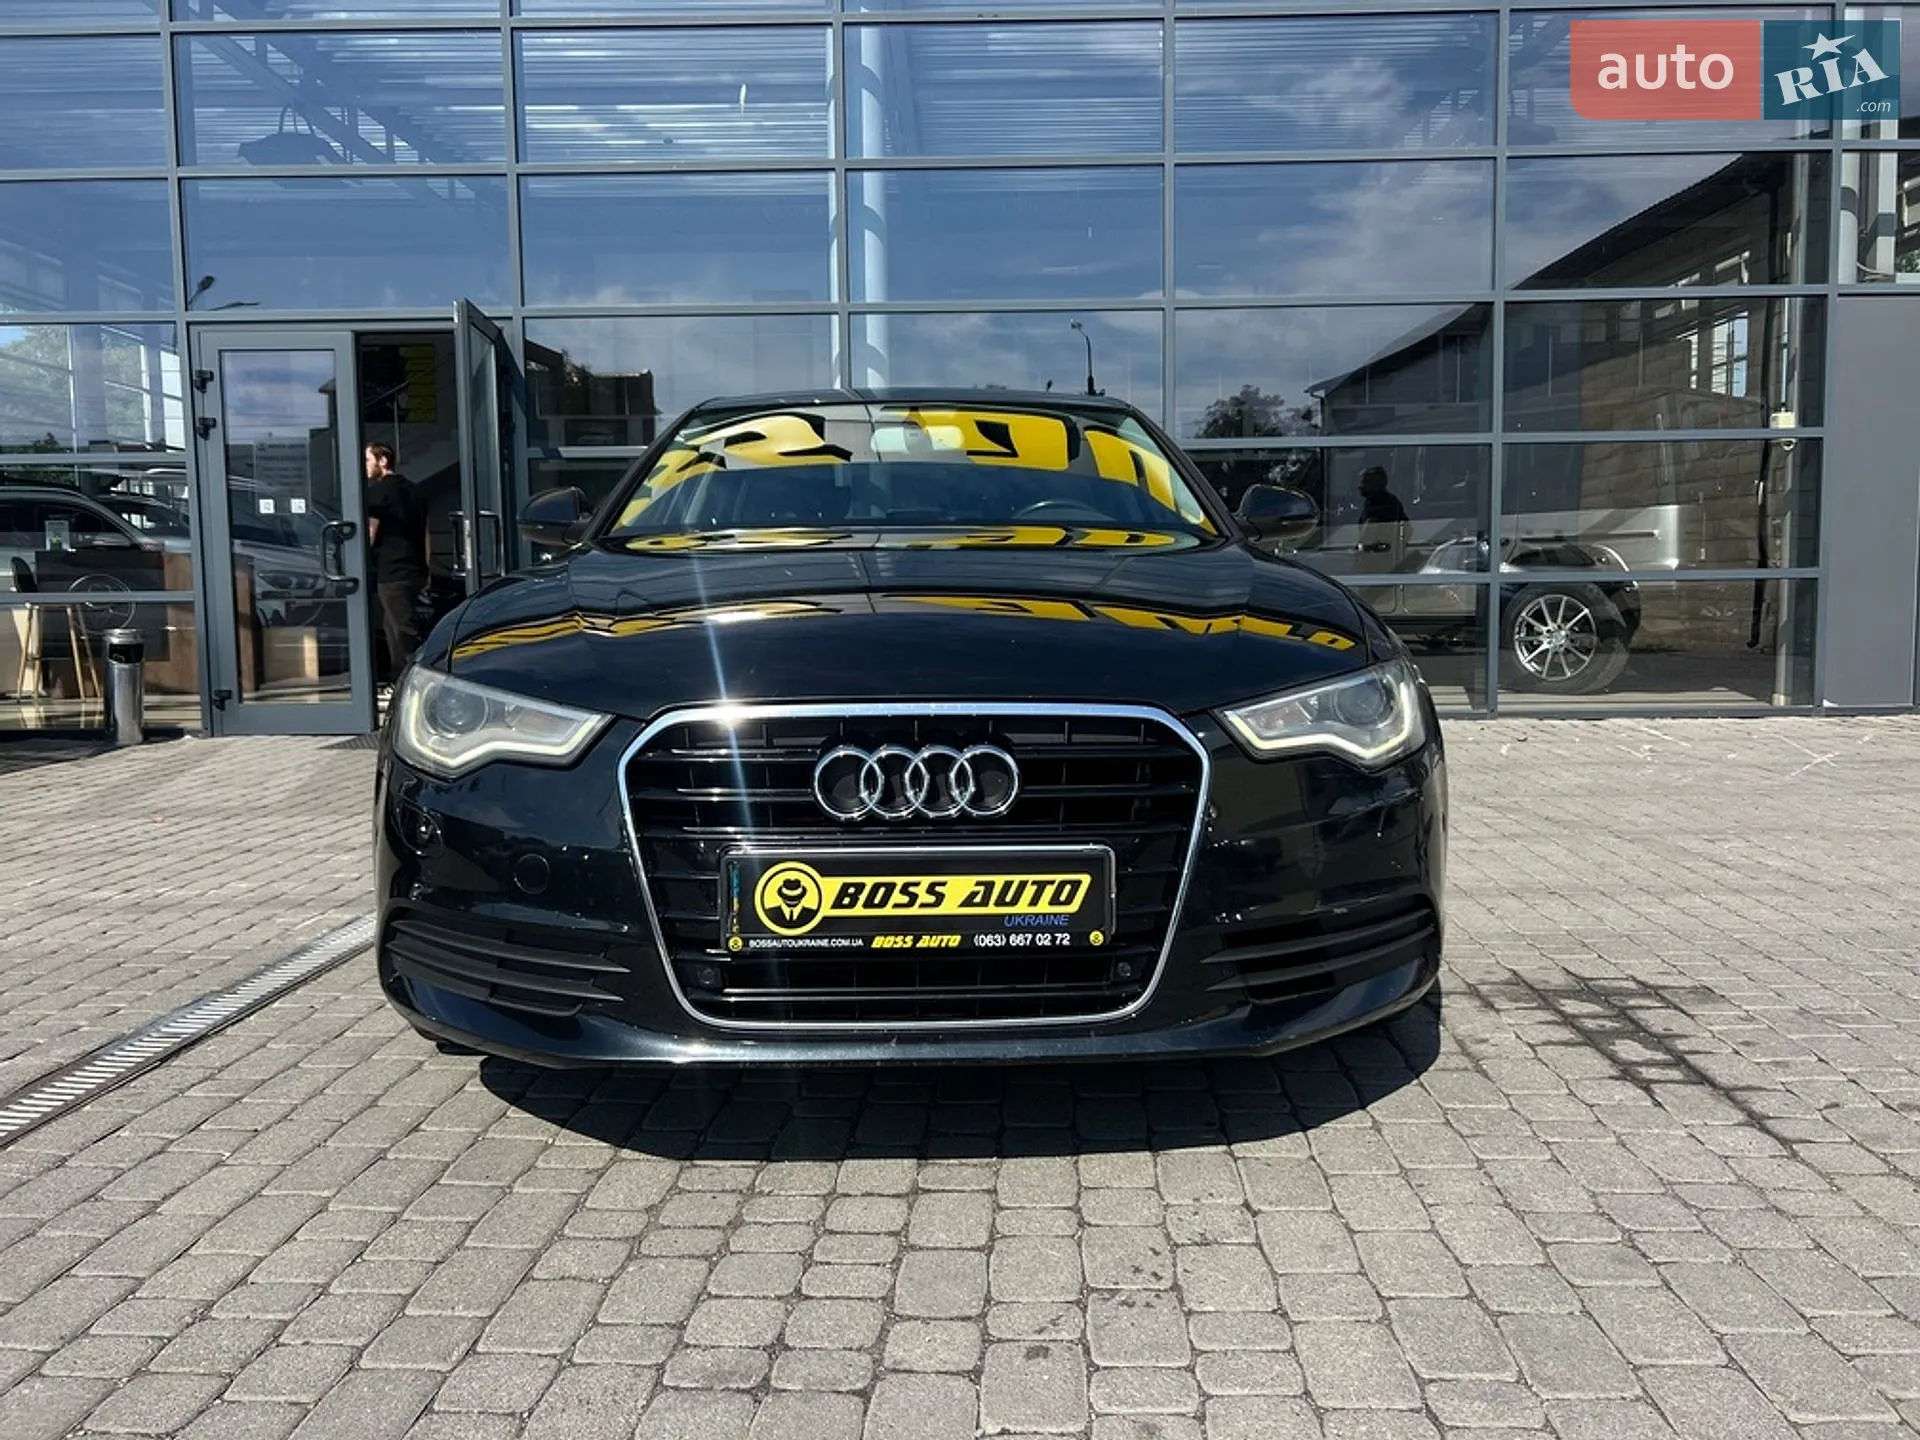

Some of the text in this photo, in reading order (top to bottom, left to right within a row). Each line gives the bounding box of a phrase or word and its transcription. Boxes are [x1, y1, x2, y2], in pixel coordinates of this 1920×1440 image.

[830, 878, 1083, 909] BOSS AUTO
[1003, 914, 1070, 927] UKRAINE
[749, 933, 1071, 949] BOSSAUTOUKRAINE.COM.UA BOSS AUTO (063) 667 02 72
